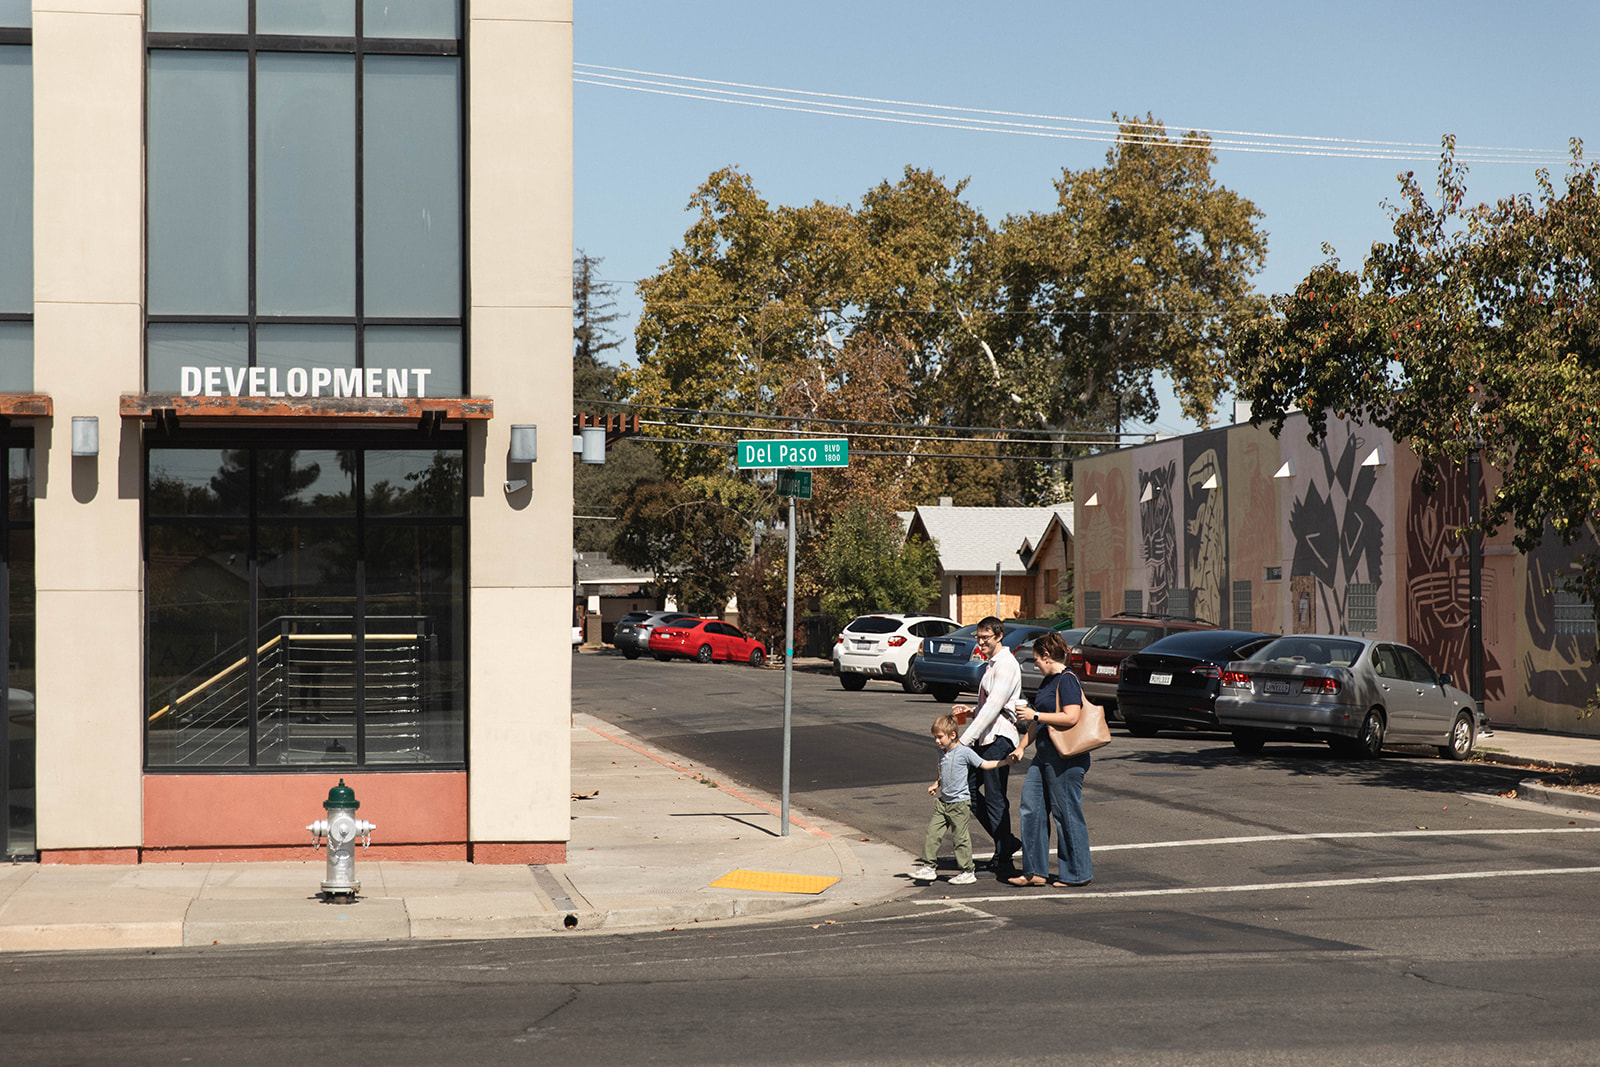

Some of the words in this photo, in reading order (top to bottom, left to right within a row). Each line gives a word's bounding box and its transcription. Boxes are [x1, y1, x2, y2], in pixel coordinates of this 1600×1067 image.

[180, 366, 432, 398] DEVELOPMENT
[746, 444, 772, 463] Del
[779, 445, 817, 462] Paso
[824, 444, 841, 453] BLVD
[824, 454, 841, 462] 1800
